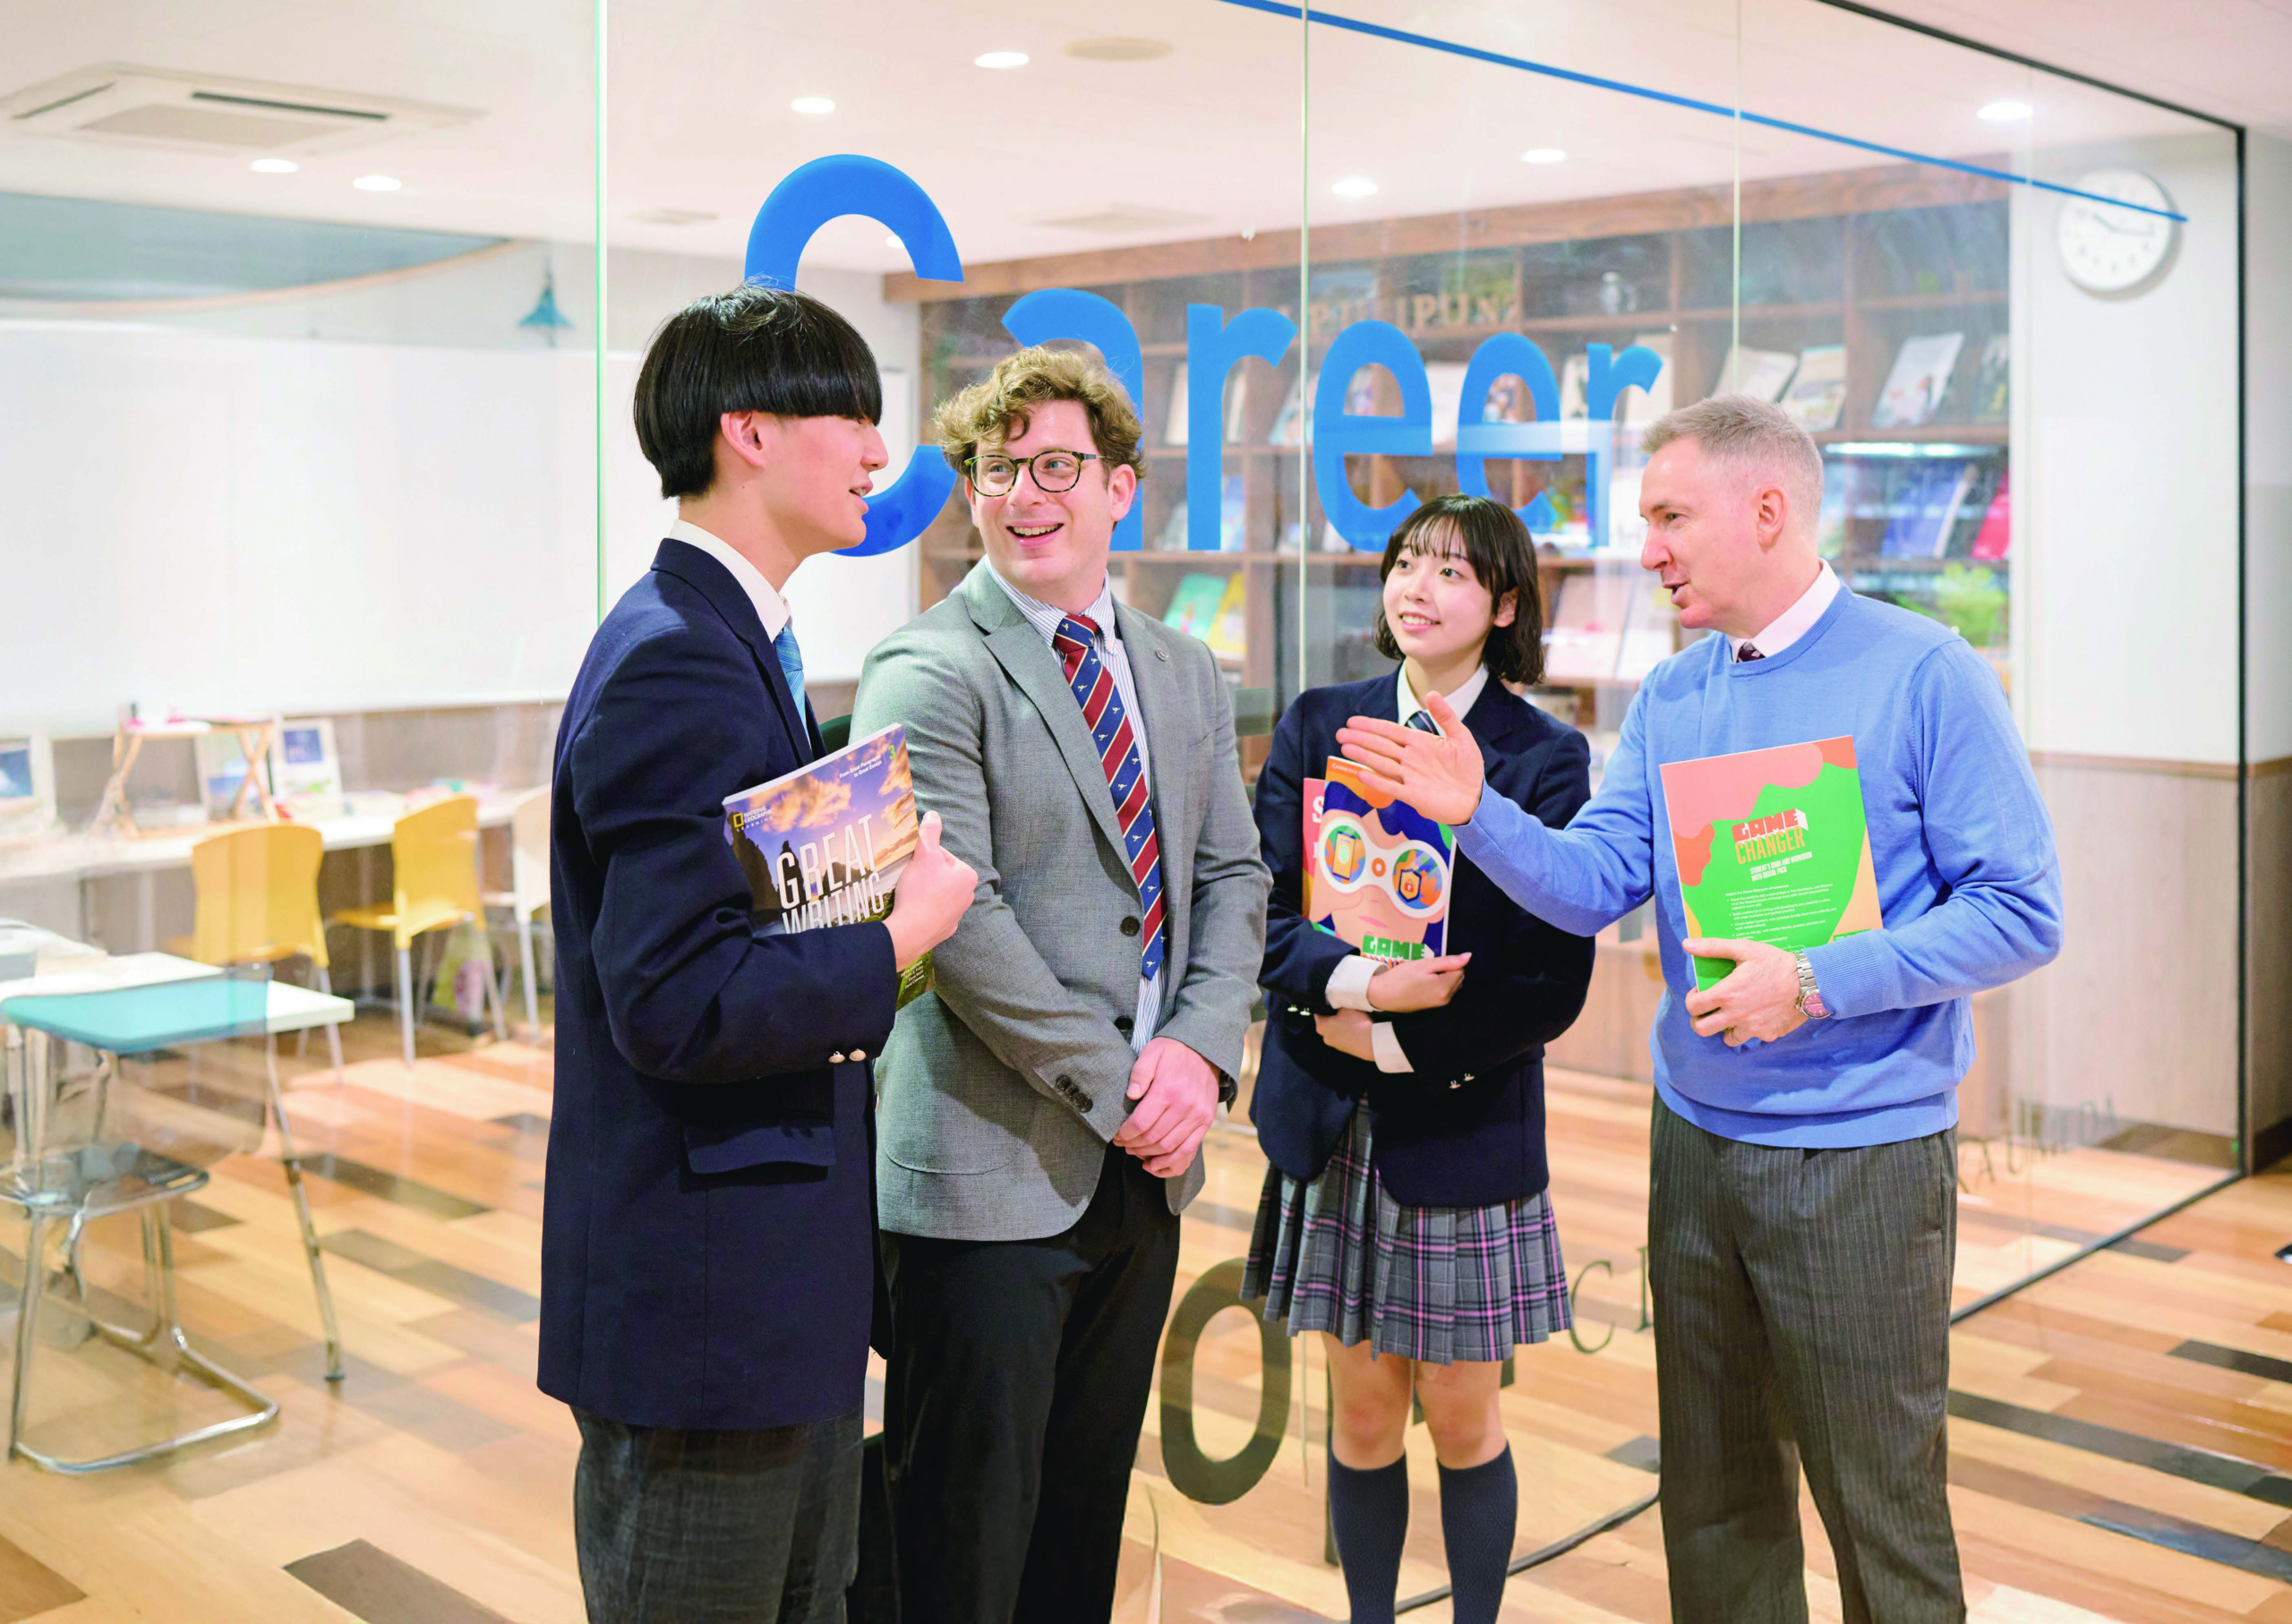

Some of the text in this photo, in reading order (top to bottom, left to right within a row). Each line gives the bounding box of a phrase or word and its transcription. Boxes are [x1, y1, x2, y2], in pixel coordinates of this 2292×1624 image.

[888, 744, 896, 760] 3
[1732, 808, 1801, 843] GAME
[776, 813, 876, 910] GREAT
[1735, 825, 1805, 865] CHANGER
[782, 871, 885, 935] WRITING
[1363, 935, 1428, 961] GAME
